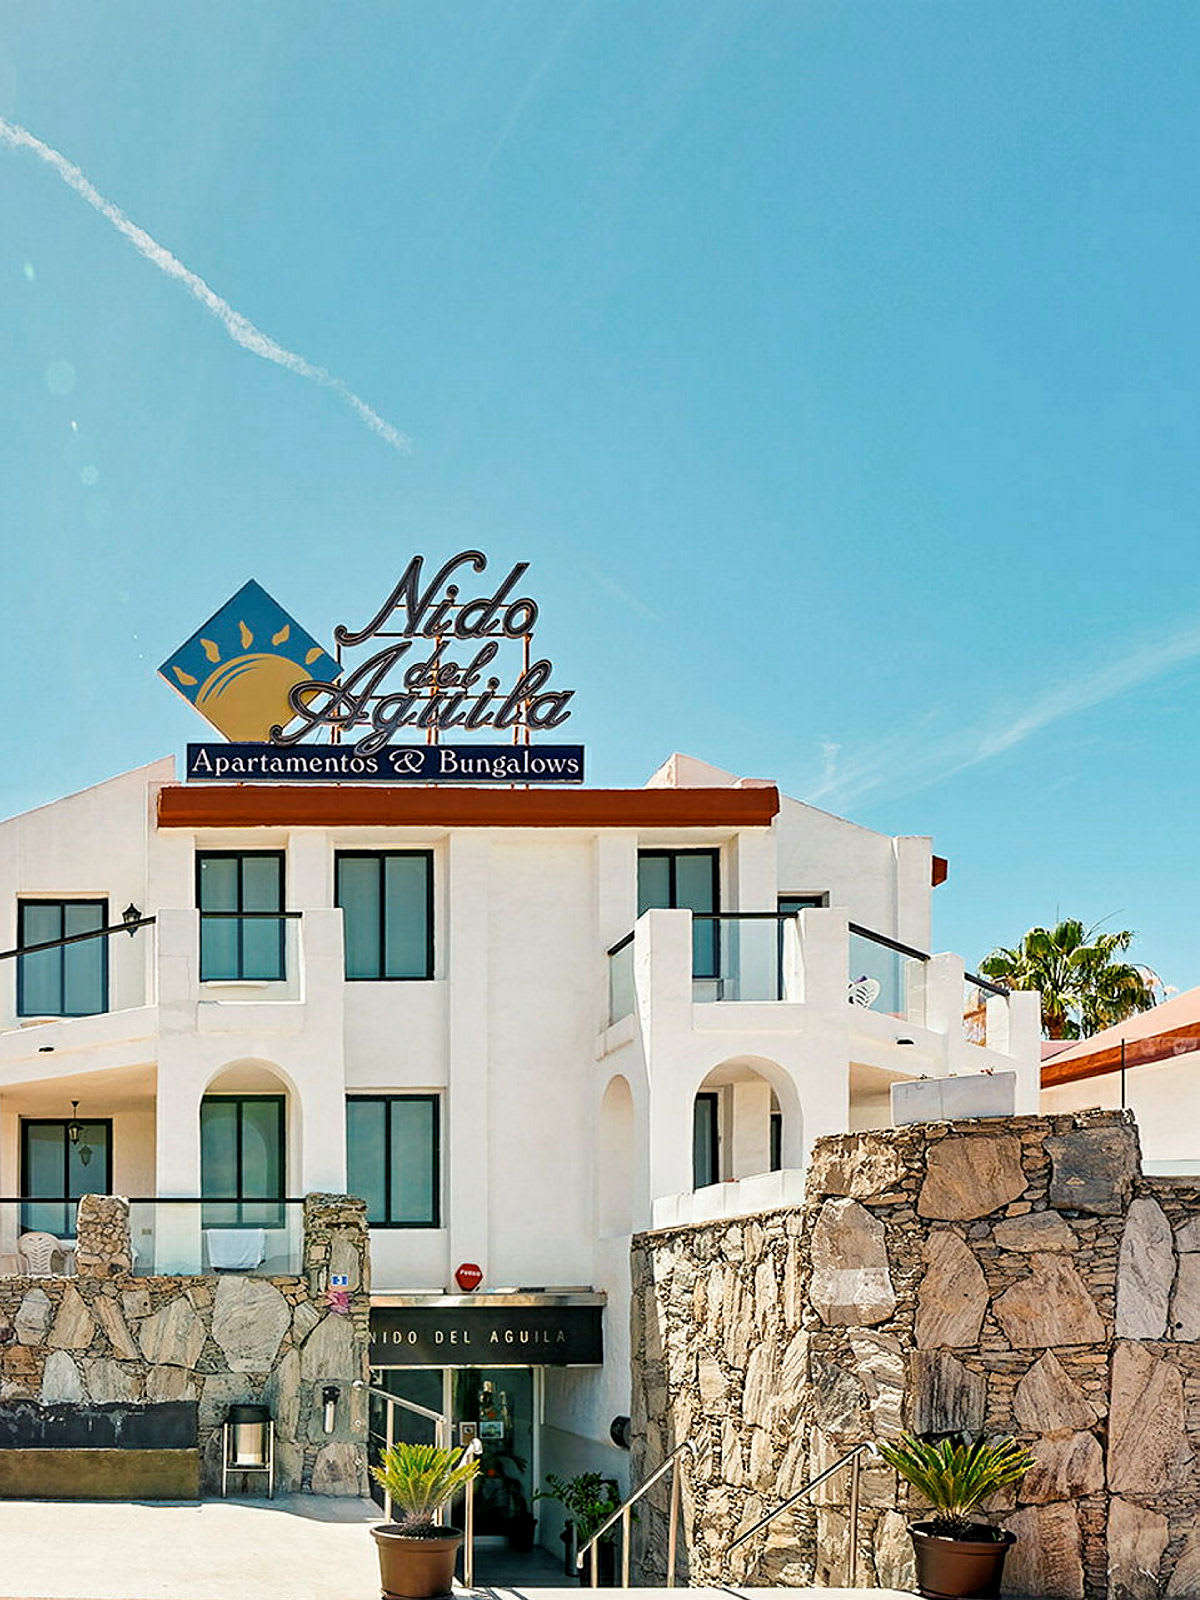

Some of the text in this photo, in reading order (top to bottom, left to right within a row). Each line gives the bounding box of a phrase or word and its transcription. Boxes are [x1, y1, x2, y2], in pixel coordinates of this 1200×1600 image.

[334, 549, 538, 646] Nido
[403, 640, 498, 690] del
[269, 640, 575, 757] Aguila
[191, 748, 580, 778] Apartamentos & Bungalows
[435, 1331, 471, 1344] DEL
[490, 1331, 566, 1344] AGUILA
